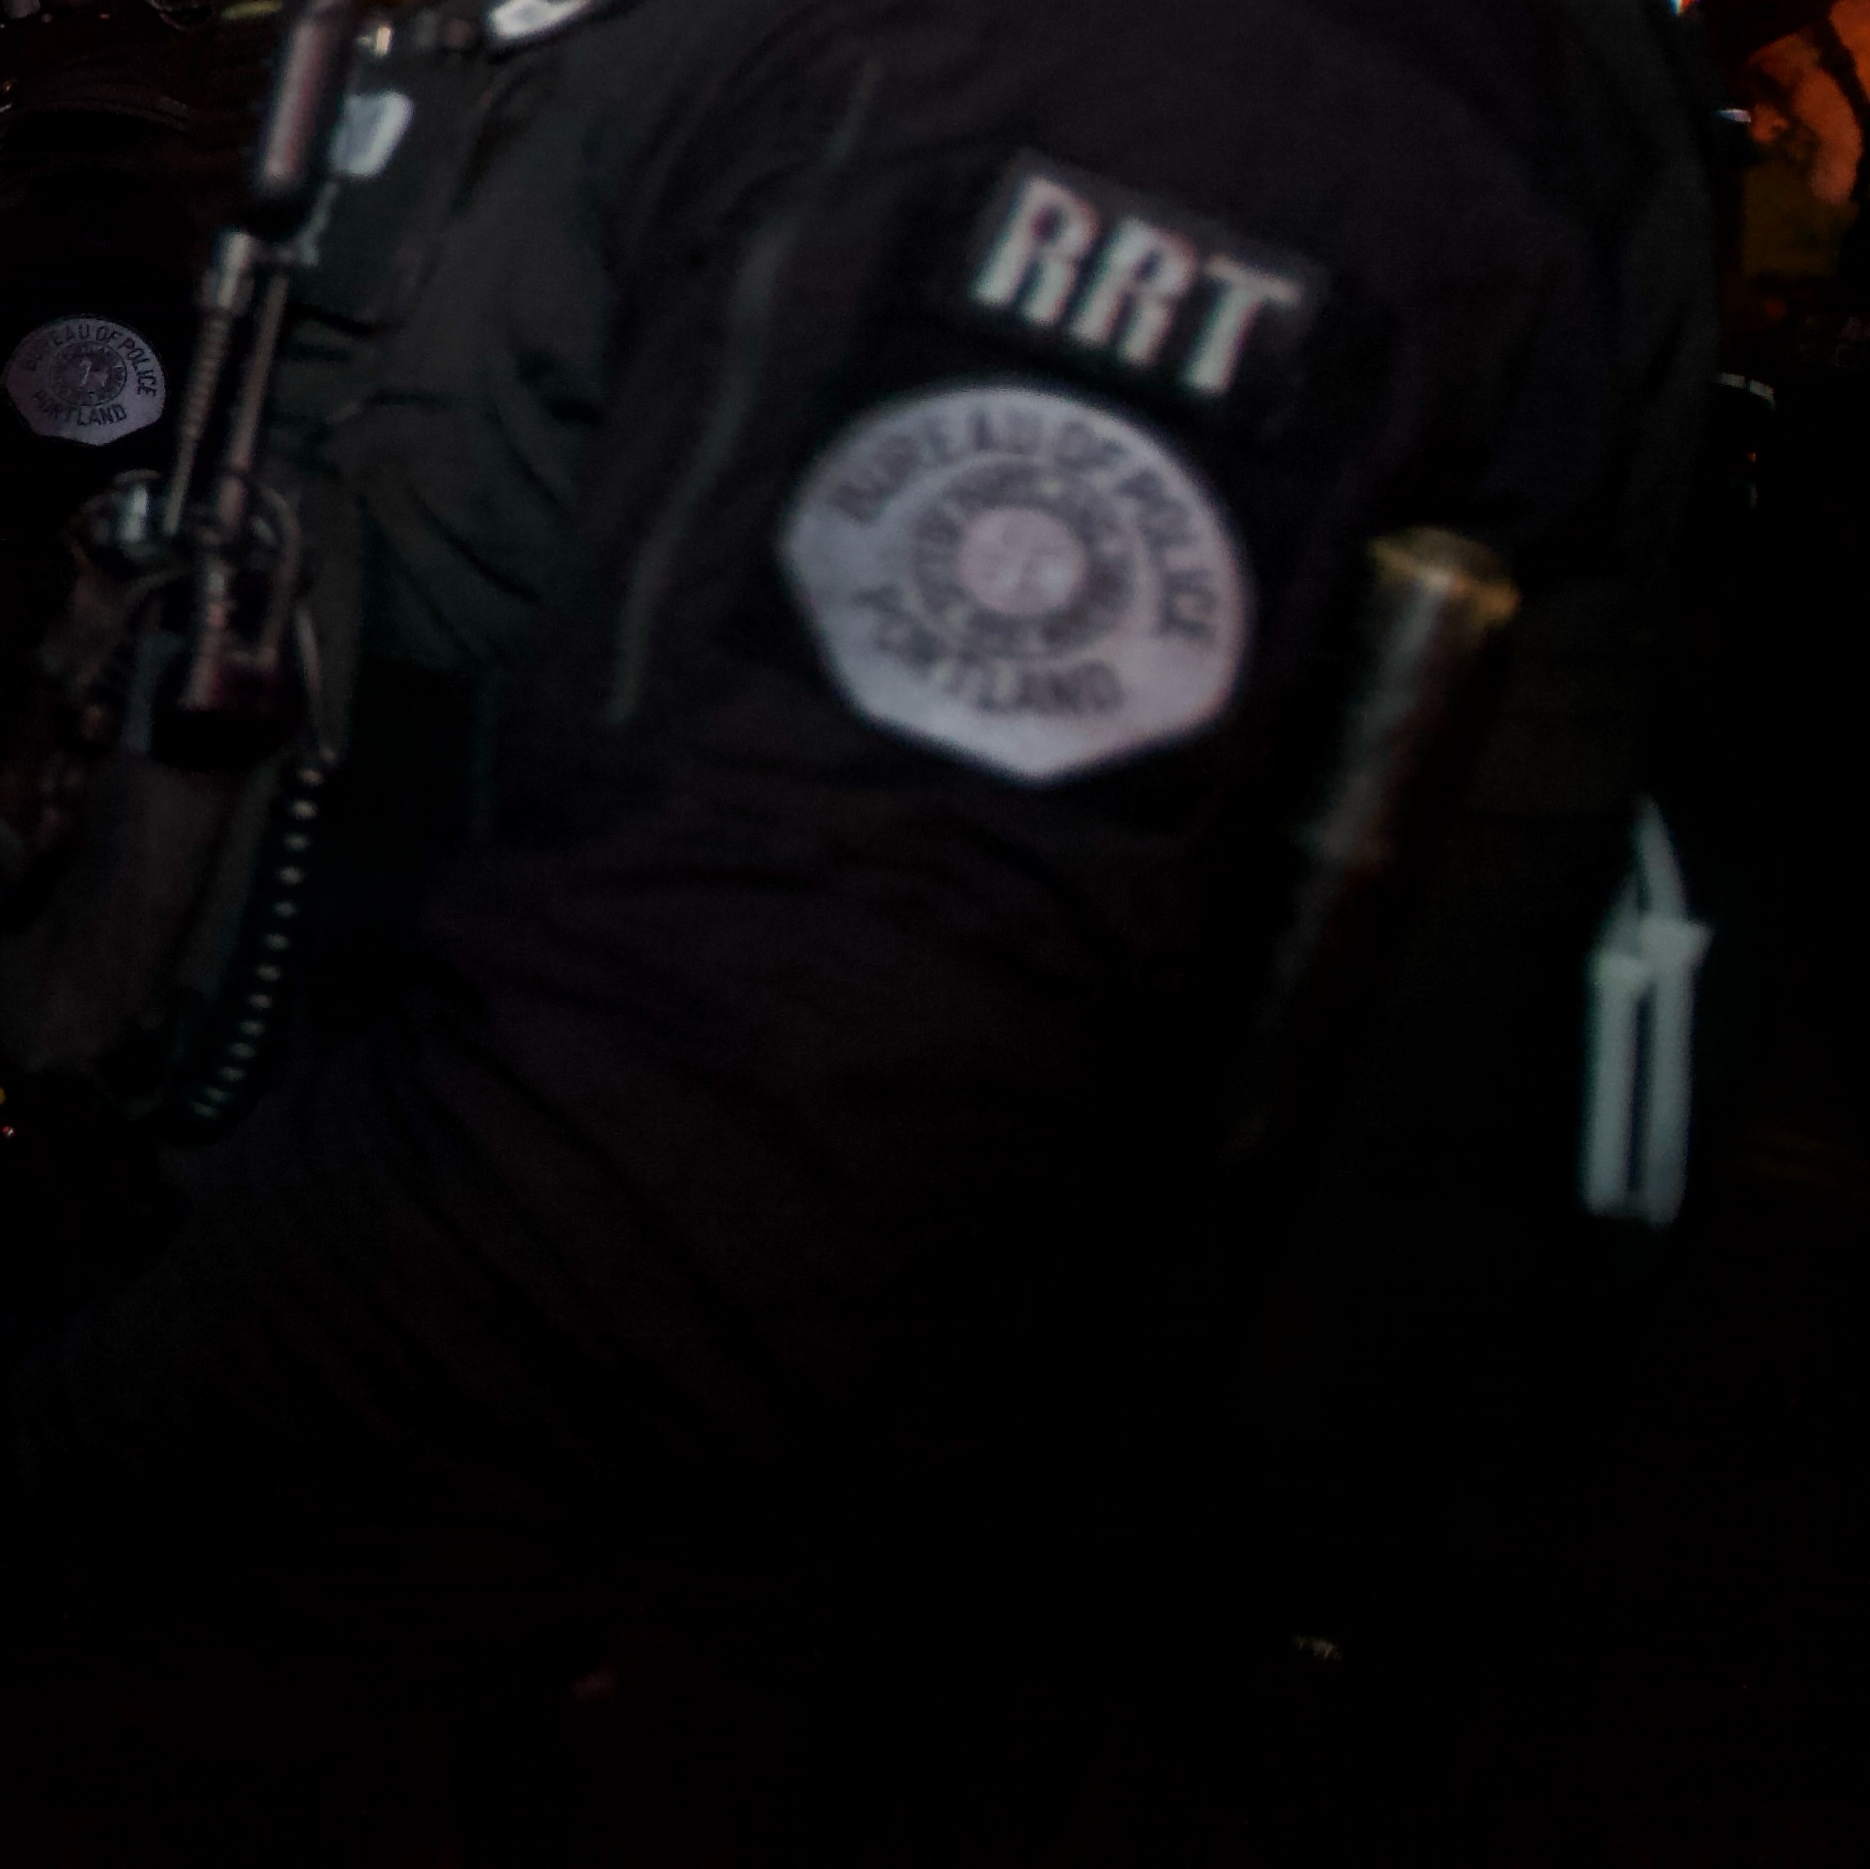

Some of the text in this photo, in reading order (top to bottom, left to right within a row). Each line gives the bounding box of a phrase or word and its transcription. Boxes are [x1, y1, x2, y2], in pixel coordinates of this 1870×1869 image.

[970, 175, 1304, 396] RRT
[96, 325, 123, 344] OF
[118, 337, 159, 398] POLICE
[32, 388, 128, 427] PORTLAND
